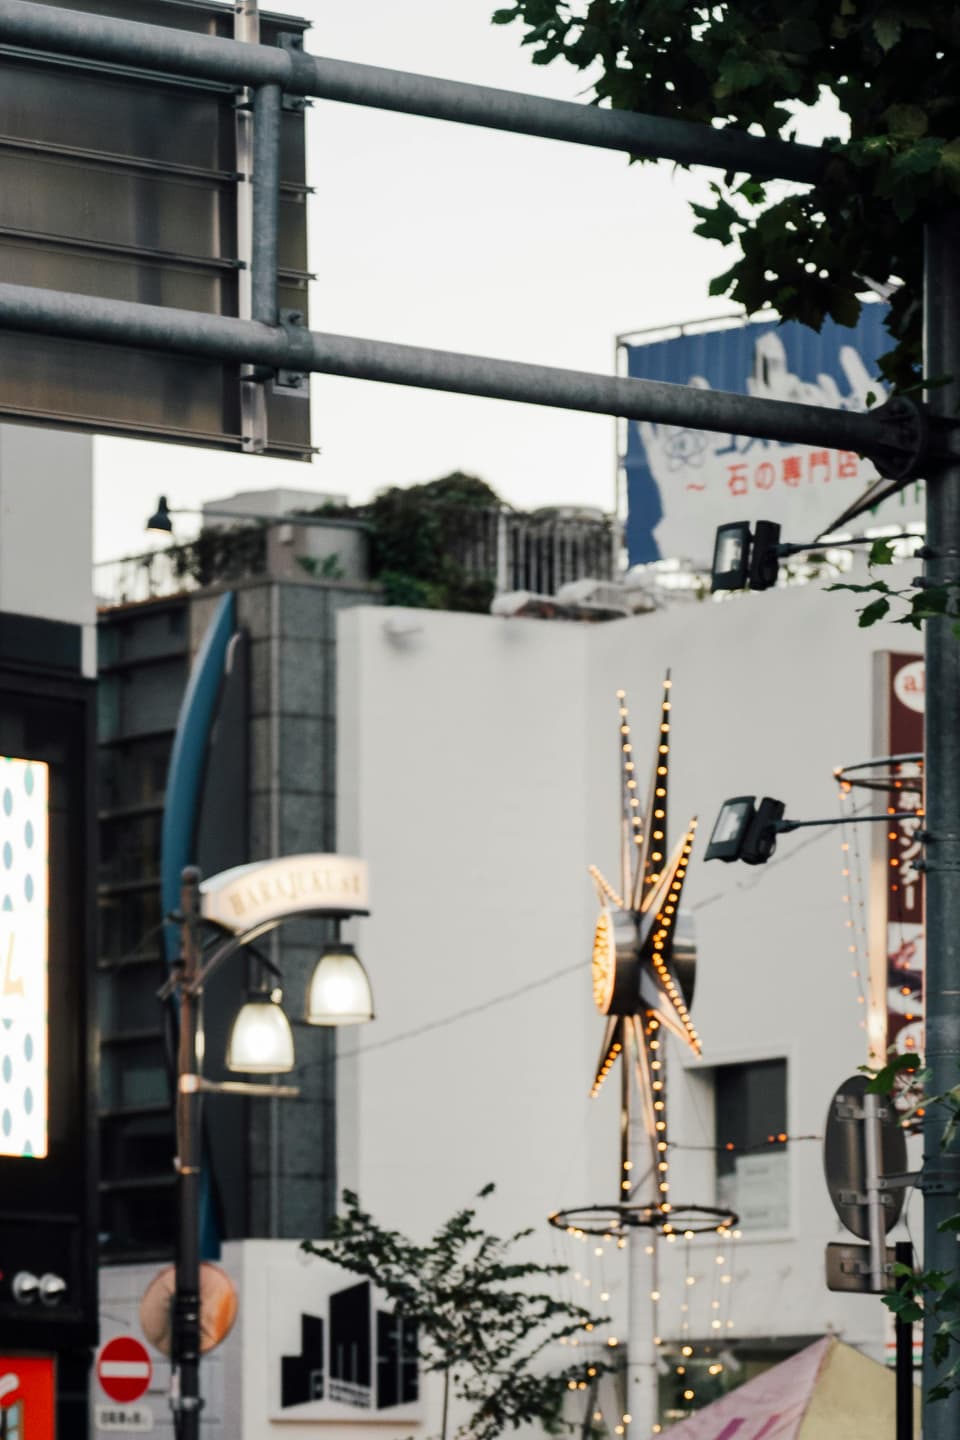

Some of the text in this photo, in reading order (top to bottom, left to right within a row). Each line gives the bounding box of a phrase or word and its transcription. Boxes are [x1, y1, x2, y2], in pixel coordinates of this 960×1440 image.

[725, 449, 859, 496] 石の専門店
